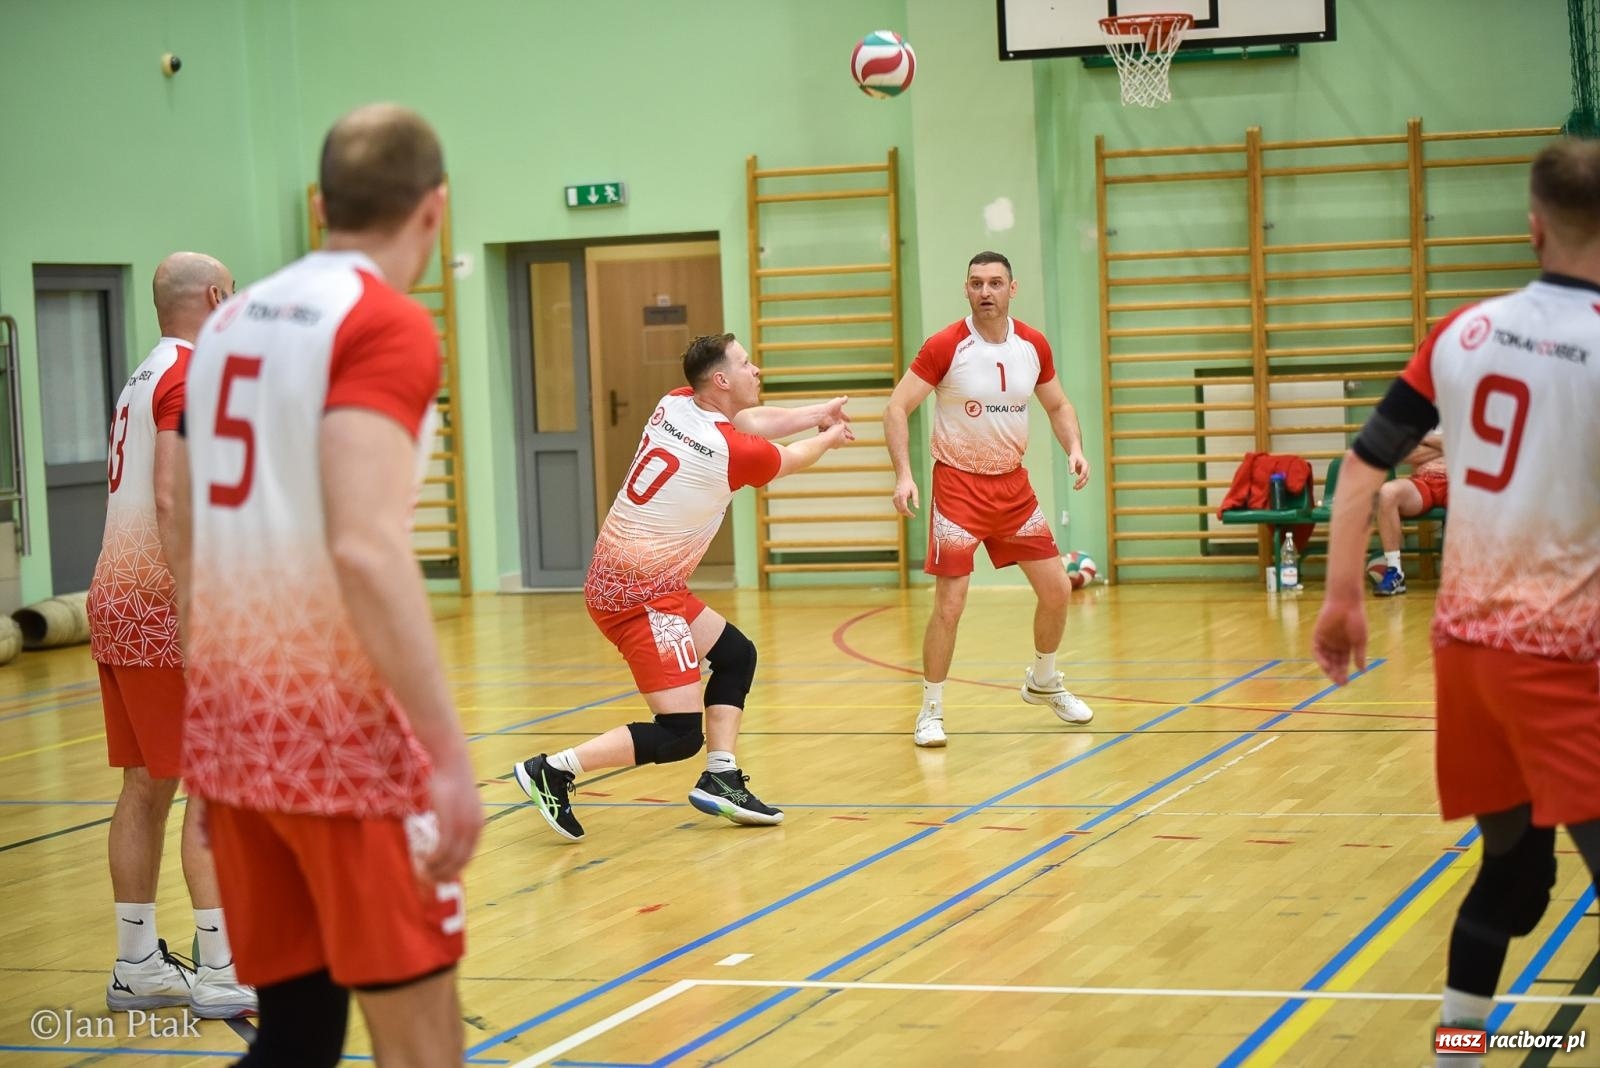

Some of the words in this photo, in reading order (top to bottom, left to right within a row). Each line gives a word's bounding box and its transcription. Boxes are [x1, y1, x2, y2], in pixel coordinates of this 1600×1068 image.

[996, 361, 1007, 392] 1
[985, 405, 1008, 413] TOKAI
[209, 355, 262, 508] 5
[661, 419, 684, 441] TOKAI
[683, 435, 715, 458] COBEX
[1464, 372, 1531, 494] 9
[621, 432, 680, 506] 10
[669, 635, 699, 673] 10
